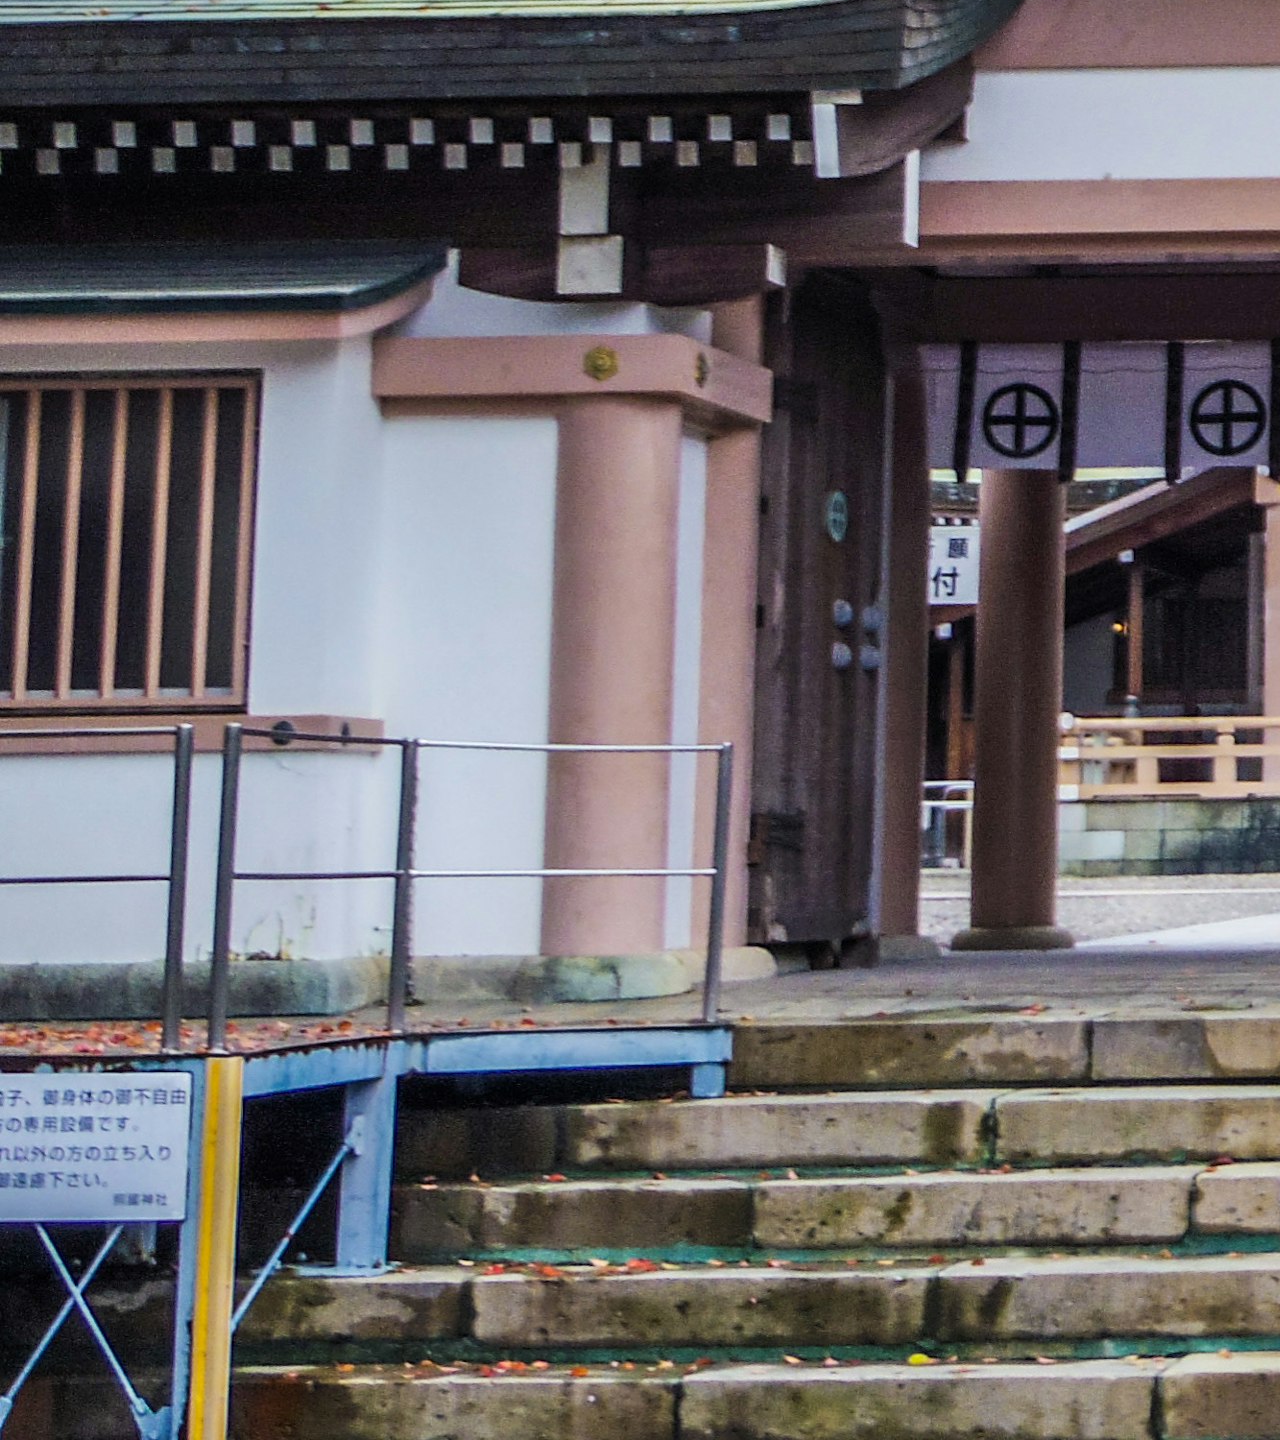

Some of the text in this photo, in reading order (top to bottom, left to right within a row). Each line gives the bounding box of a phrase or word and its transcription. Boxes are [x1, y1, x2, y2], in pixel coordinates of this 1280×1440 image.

[0, 1089, 187, 1107] 子、御身体の御不自由
[0, 1116, 139, 1133] の専用設備です。
